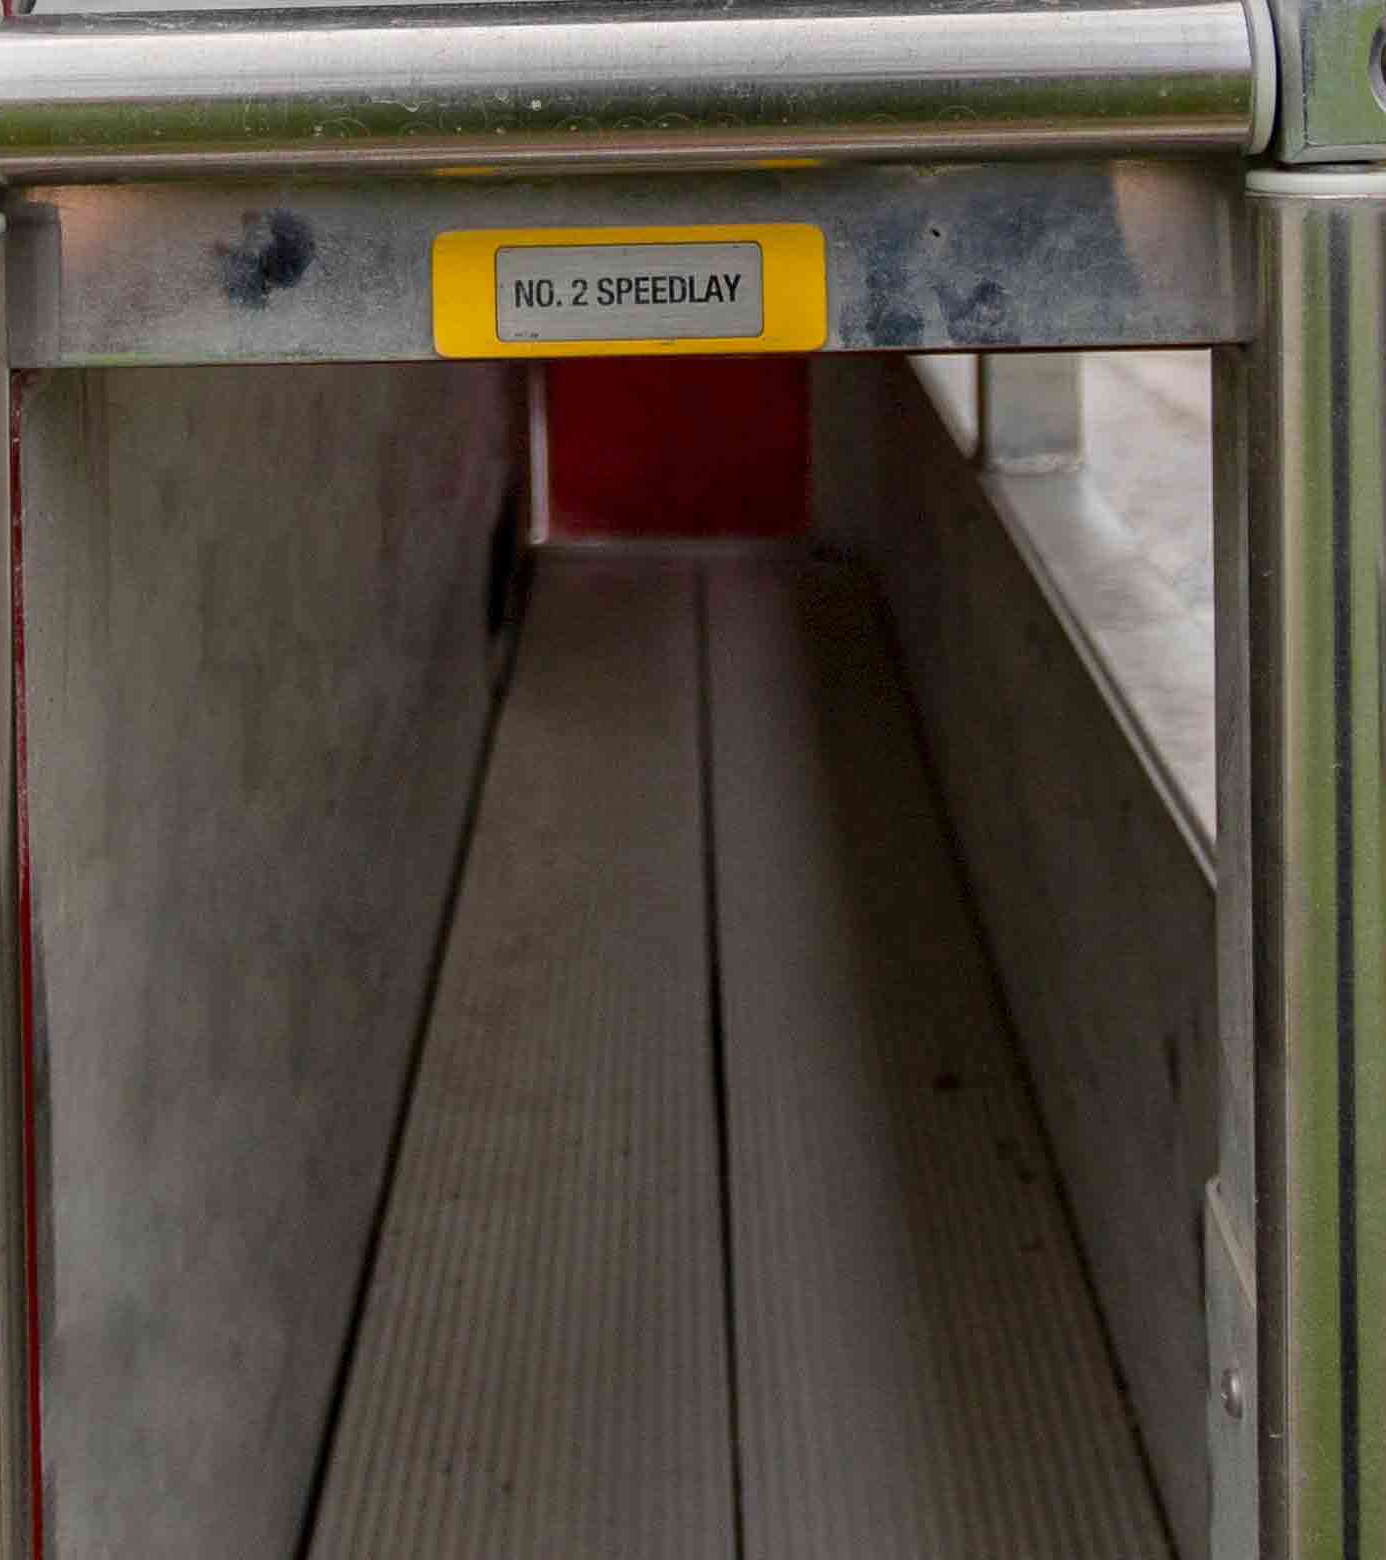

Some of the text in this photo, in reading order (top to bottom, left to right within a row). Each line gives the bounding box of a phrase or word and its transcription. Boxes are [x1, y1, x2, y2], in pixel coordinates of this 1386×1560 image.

[515, 274, 742, 308] NO. 2 SPEEDLAY
